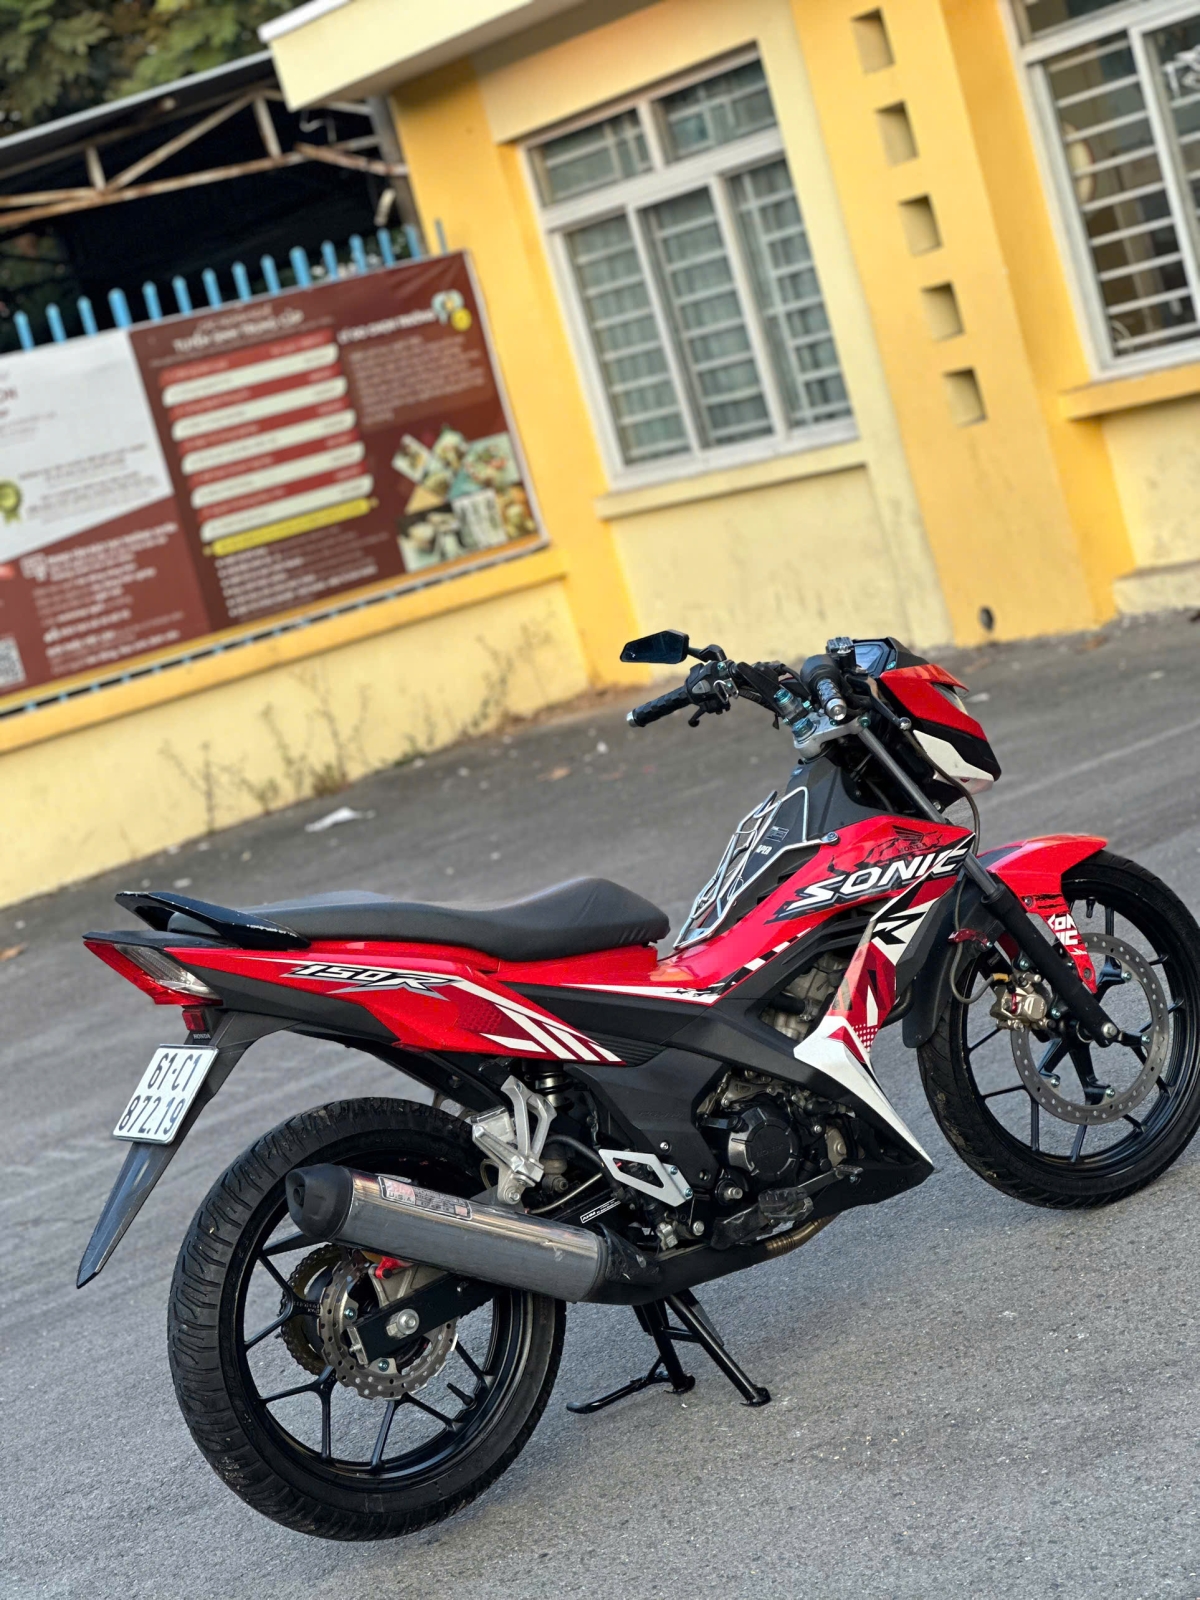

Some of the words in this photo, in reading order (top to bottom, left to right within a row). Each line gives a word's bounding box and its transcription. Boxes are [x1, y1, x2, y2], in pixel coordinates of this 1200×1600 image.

[784, 847, 970, 912] SONIC
[292, 963, 457, 992] 150R
[147, 1052, 203, 1093] 61-C1
[118, 1094, 187, 1137] 872.19
